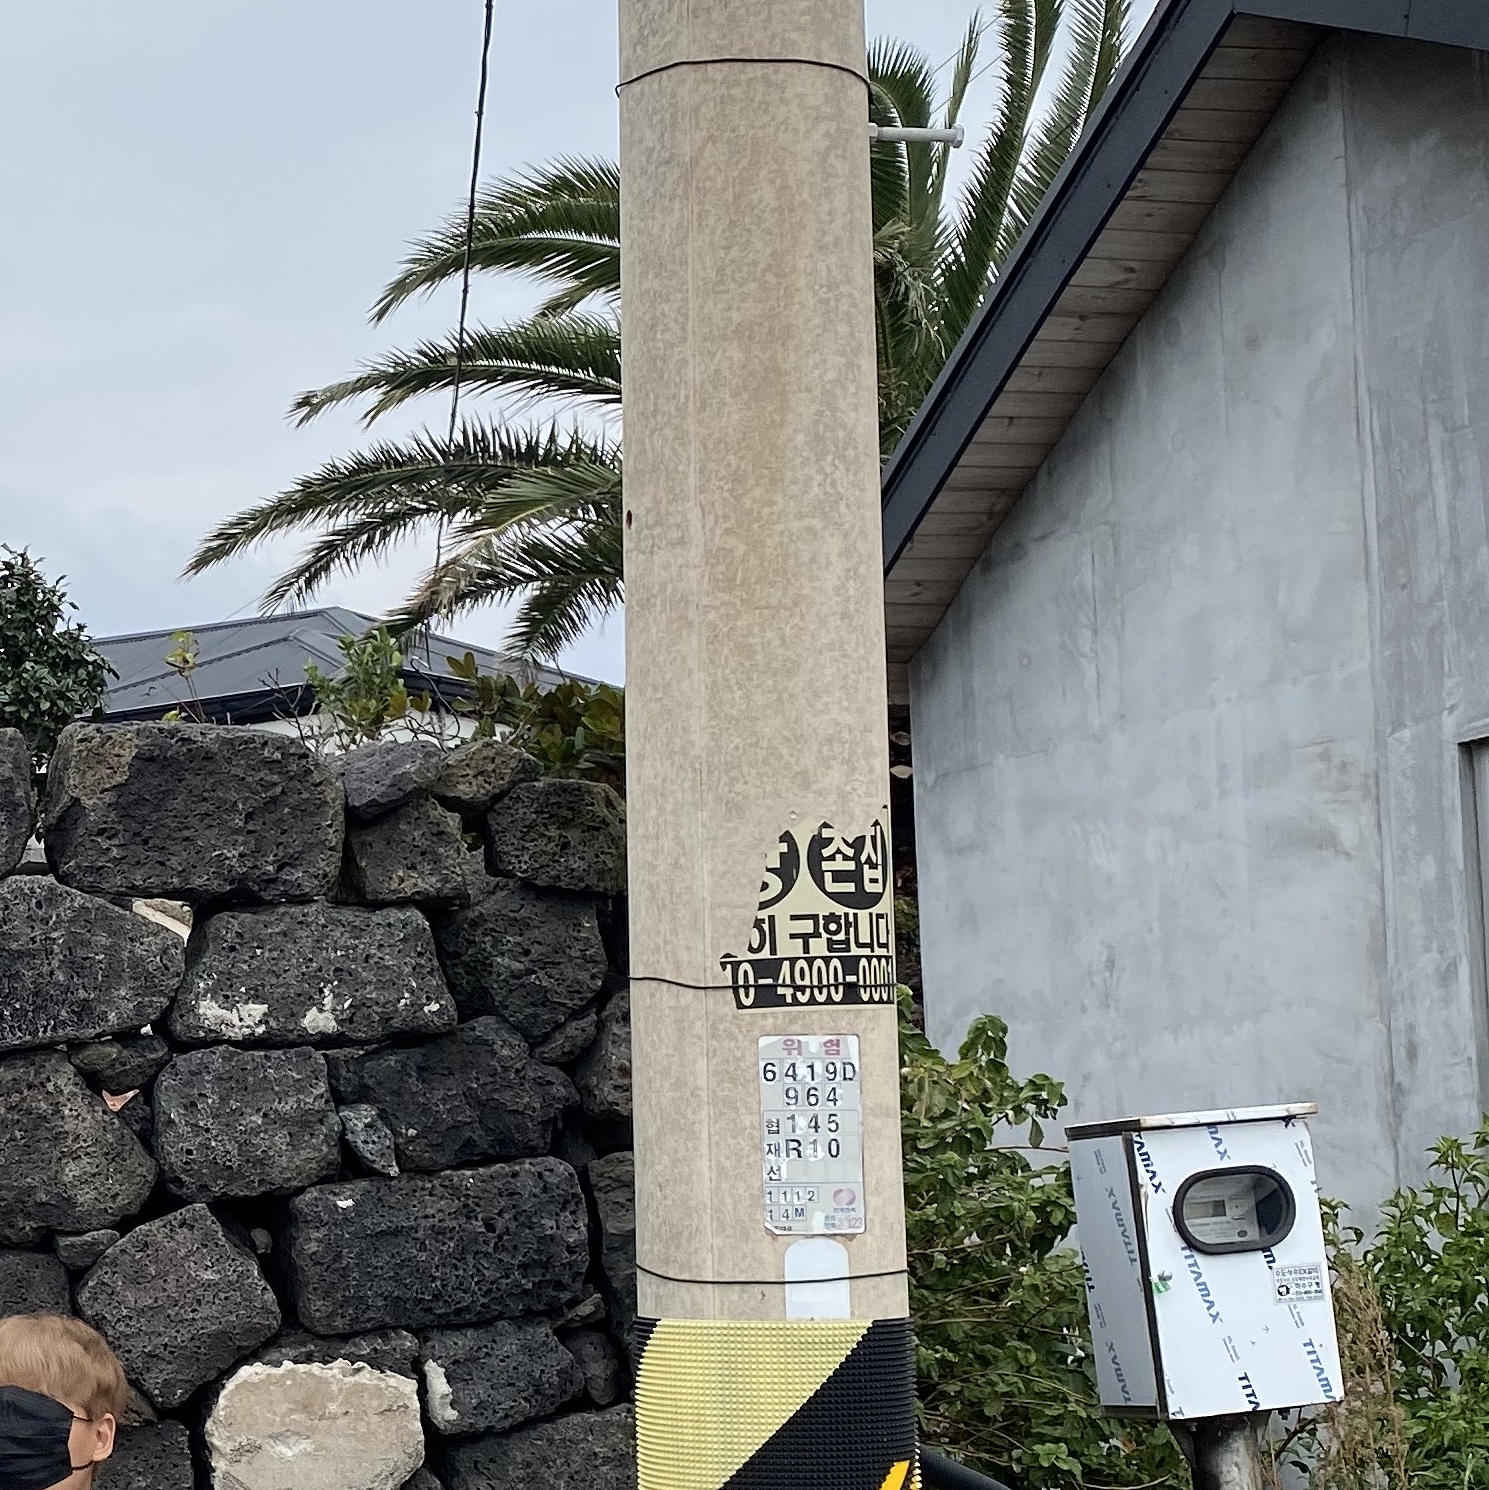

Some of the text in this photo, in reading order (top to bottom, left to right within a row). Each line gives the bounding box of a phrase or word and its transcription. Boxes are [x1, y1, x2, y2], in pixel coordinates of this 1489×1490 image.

[789, 911, 890, 955] 구합니다
[763, 1062, 857, 1082] 6419D
[785, 1086, 839, 1107] 964
[786, 1113, 840, 1134] 145
